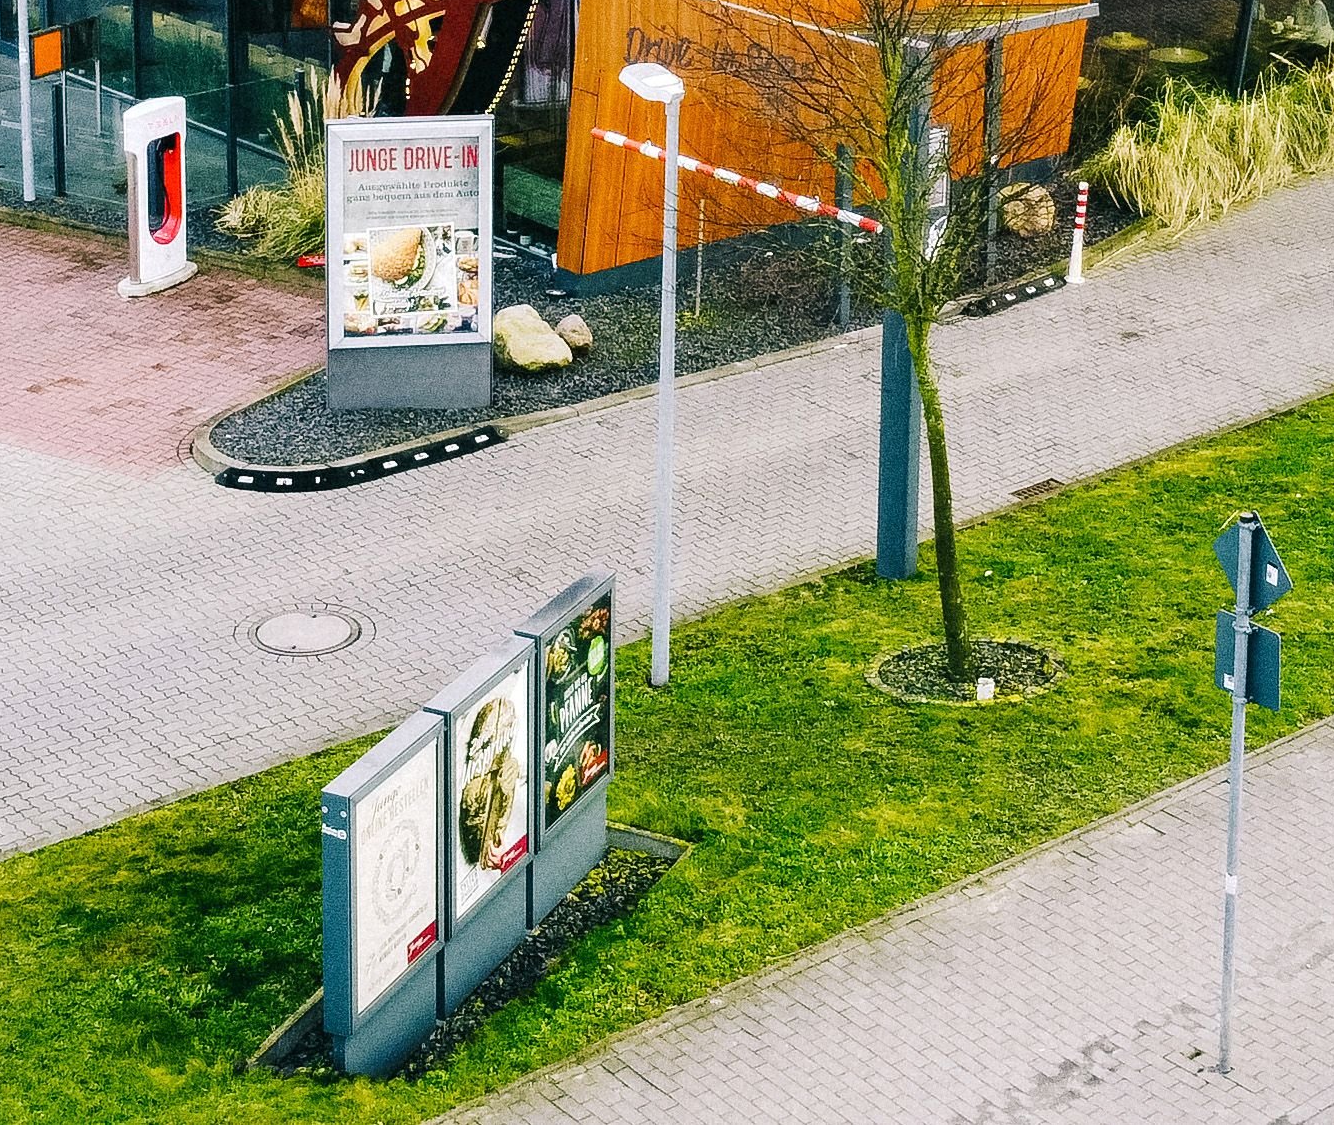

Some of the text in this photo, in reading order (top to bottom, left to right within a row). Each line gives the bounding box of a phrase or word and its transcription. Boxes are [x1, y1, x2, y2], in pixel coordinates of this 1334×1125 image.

[349, 145, 479, 172] JUNGE DRIVE-IN
[456, 190, 479, 198] Auto
